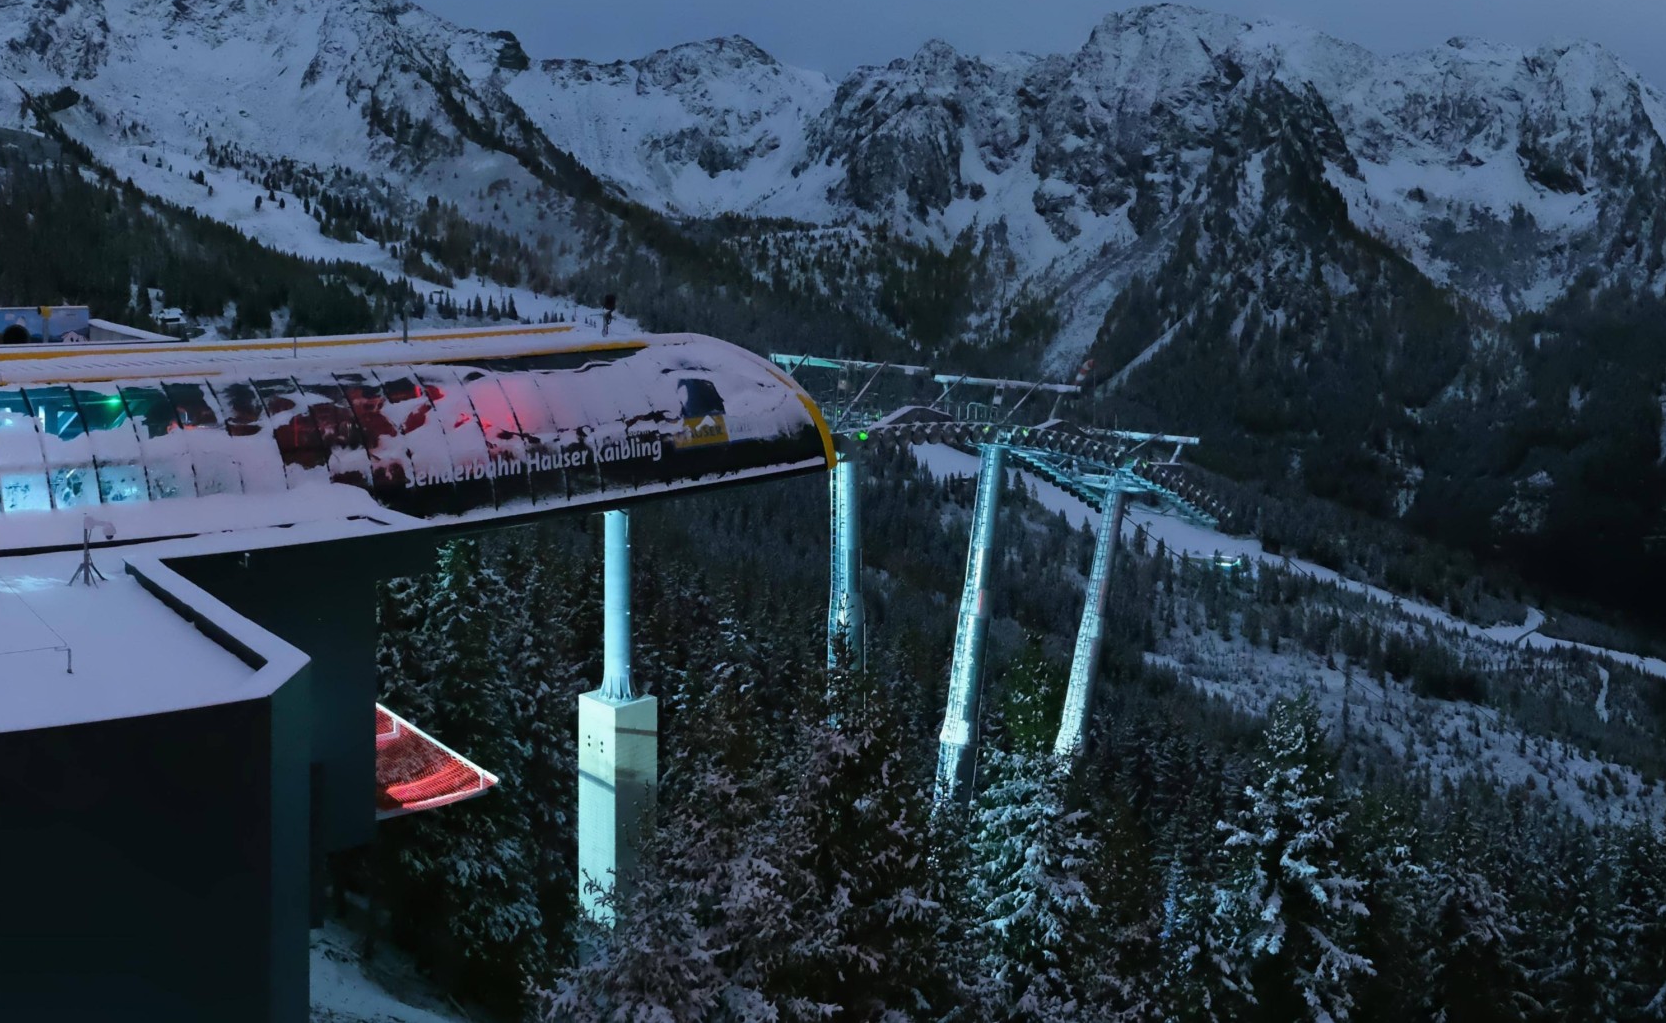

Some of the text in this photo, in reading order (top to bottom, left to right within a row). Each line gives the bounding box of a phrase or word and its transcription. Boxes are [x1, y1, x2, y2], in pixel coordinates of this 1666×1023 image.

[405, 436, 662, 488] Senderbahn Hauser Kaibling
